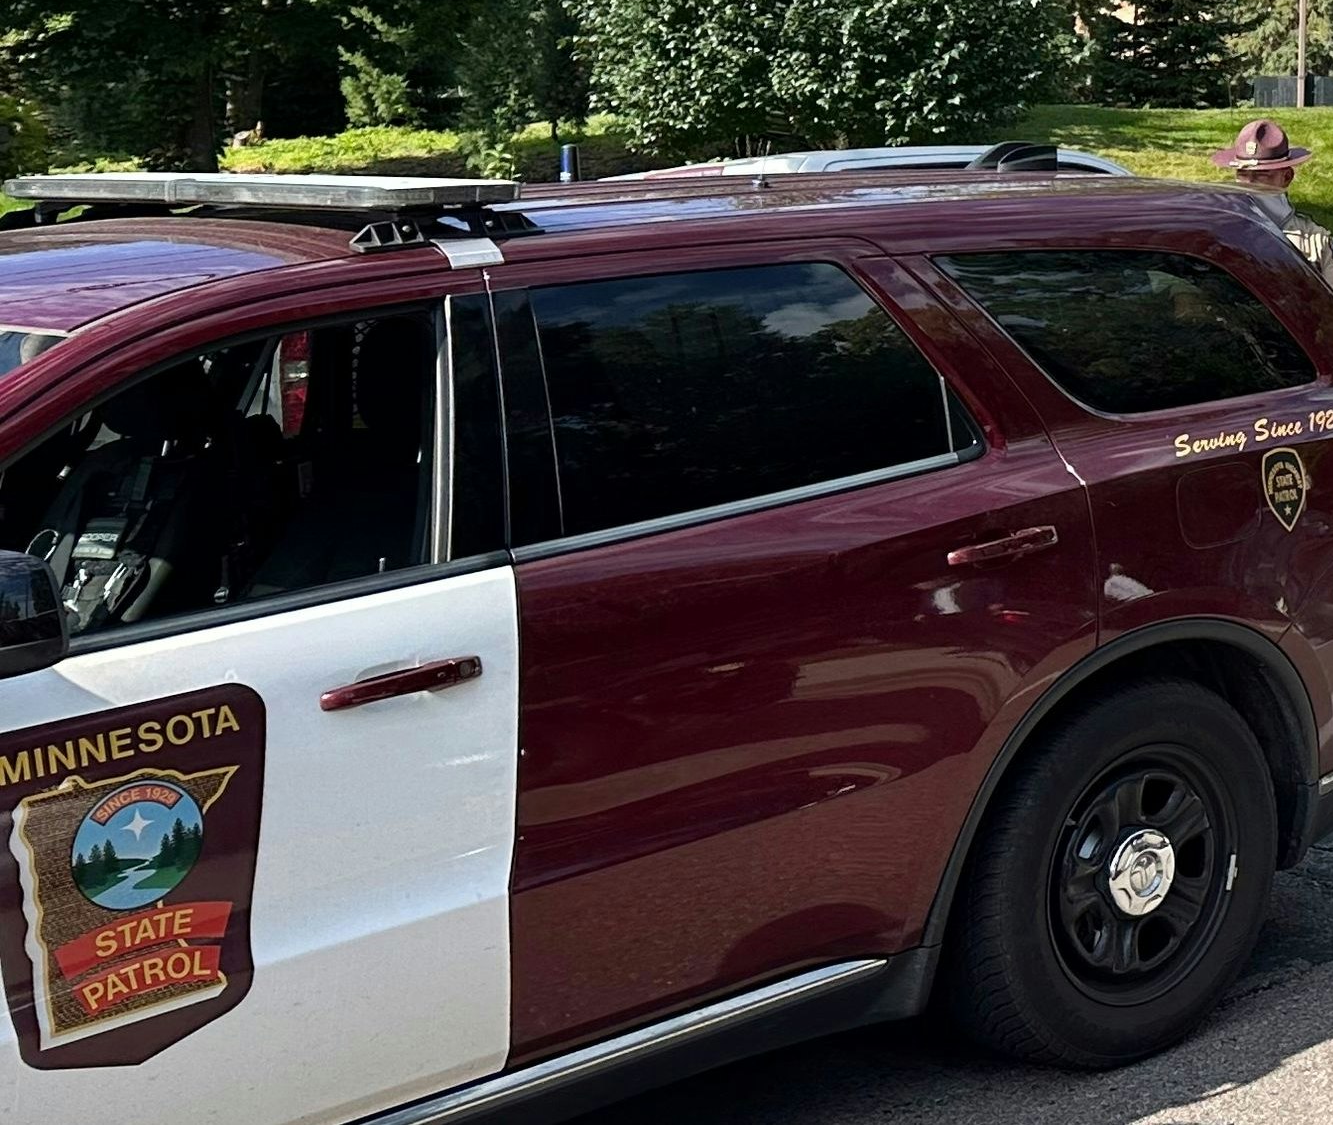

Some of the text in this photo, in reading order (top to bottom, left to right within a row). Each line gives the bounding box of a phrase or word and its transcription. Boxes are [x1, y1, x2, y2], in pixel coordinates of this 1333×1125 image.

[1174, 432, 1248, 458] Serving
[1254, 418, 1304, 442] Since
[0, 704, 240, 787] MINNESOTA
[96, 787, 178, 820] SINCE 1929
[94, 907, 193, 958] STATE
[81, 949, 212, 1011] PATROL
